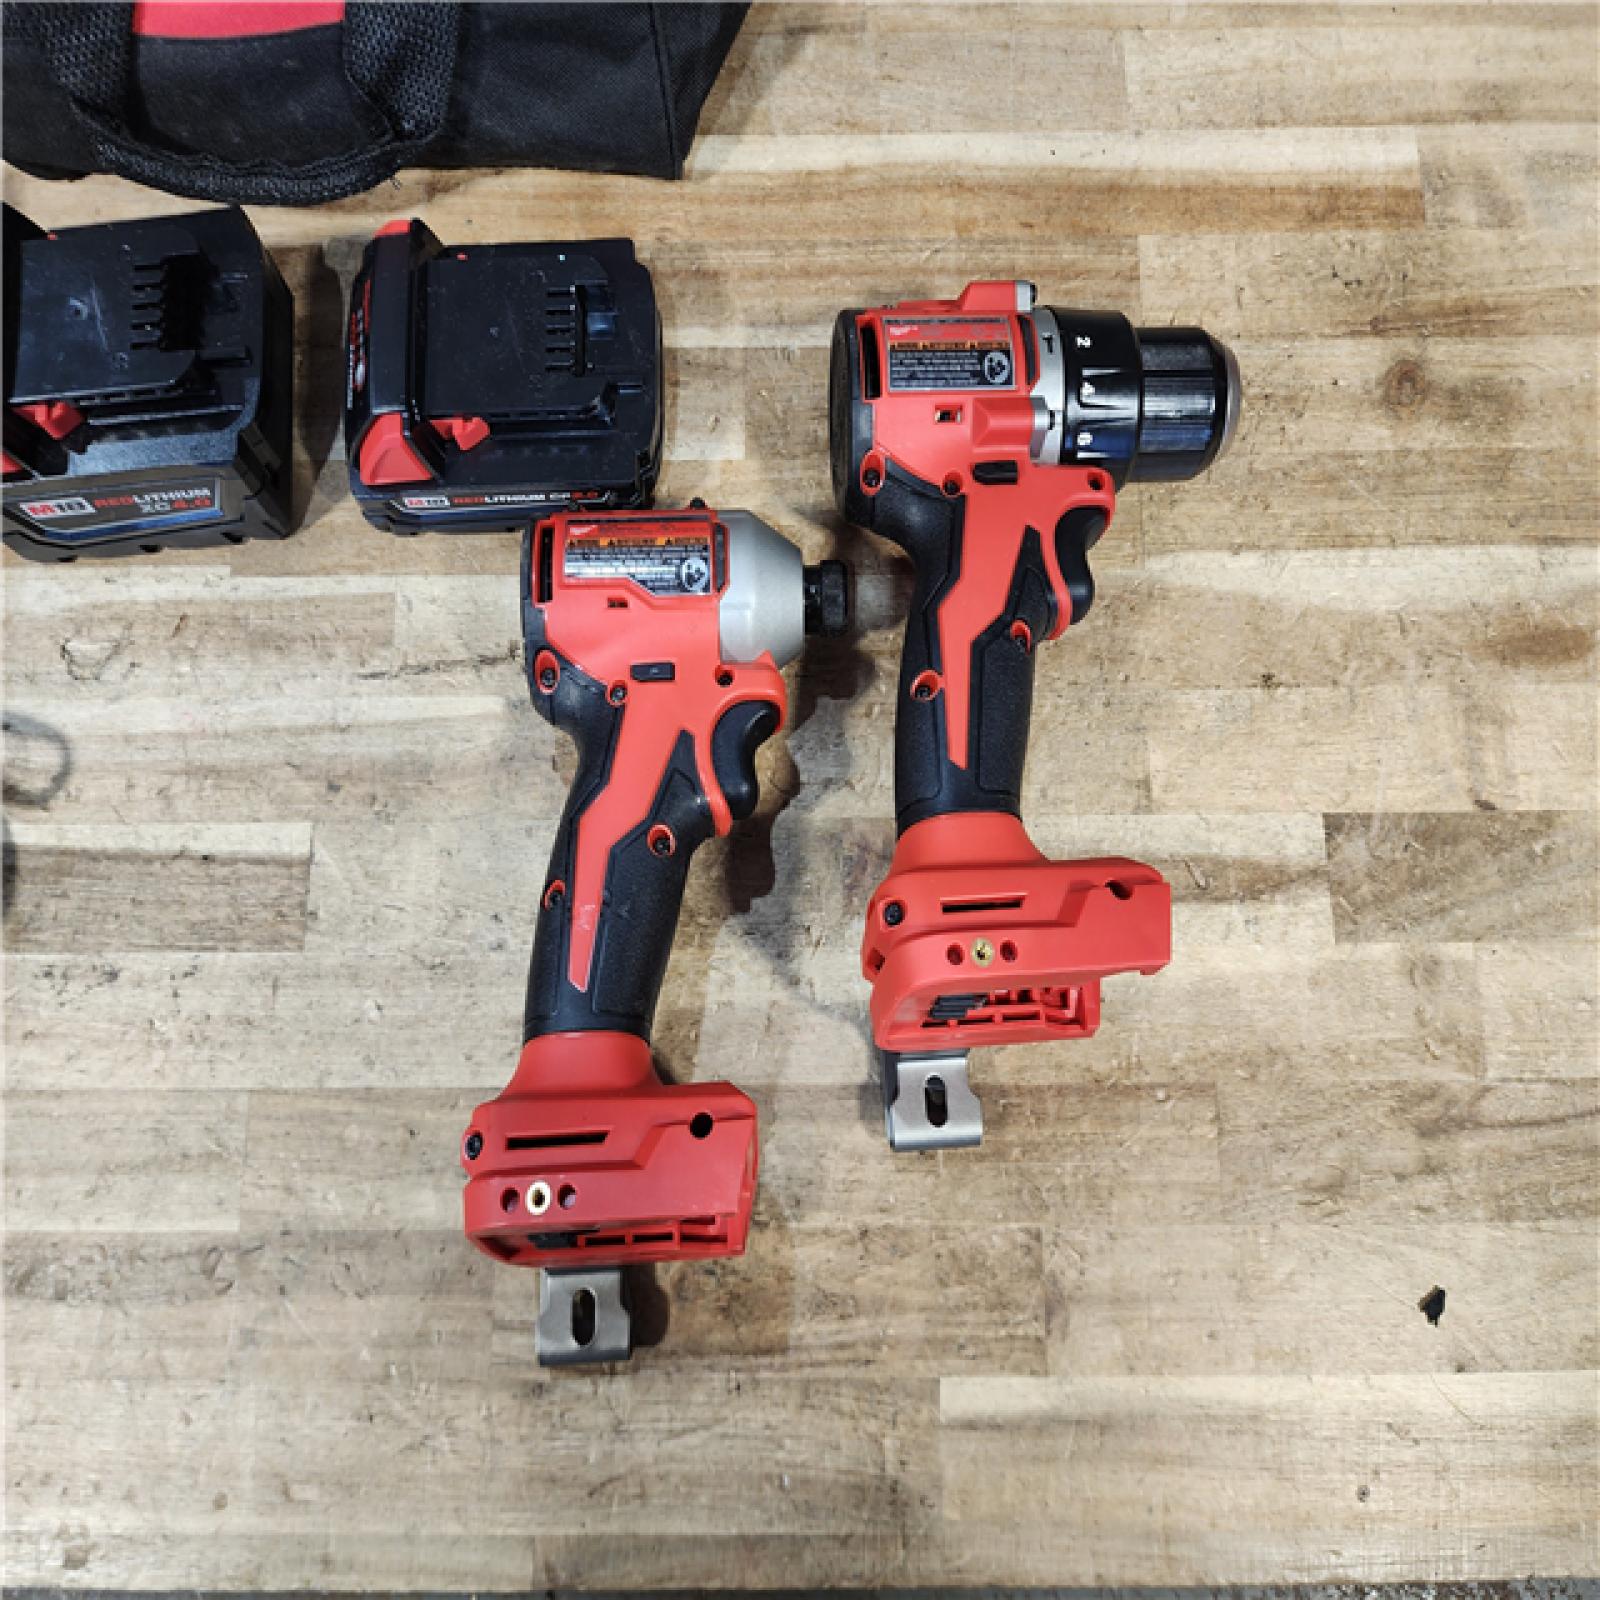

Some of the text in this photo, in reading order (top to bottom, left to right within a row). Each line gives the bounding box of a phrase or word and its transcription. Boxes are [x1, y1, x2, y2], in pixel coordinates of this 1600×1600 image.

[27, 487, 210, 515] M18 REDLITHIUM
[453, 493, 546, 504] REDLITHIUM
